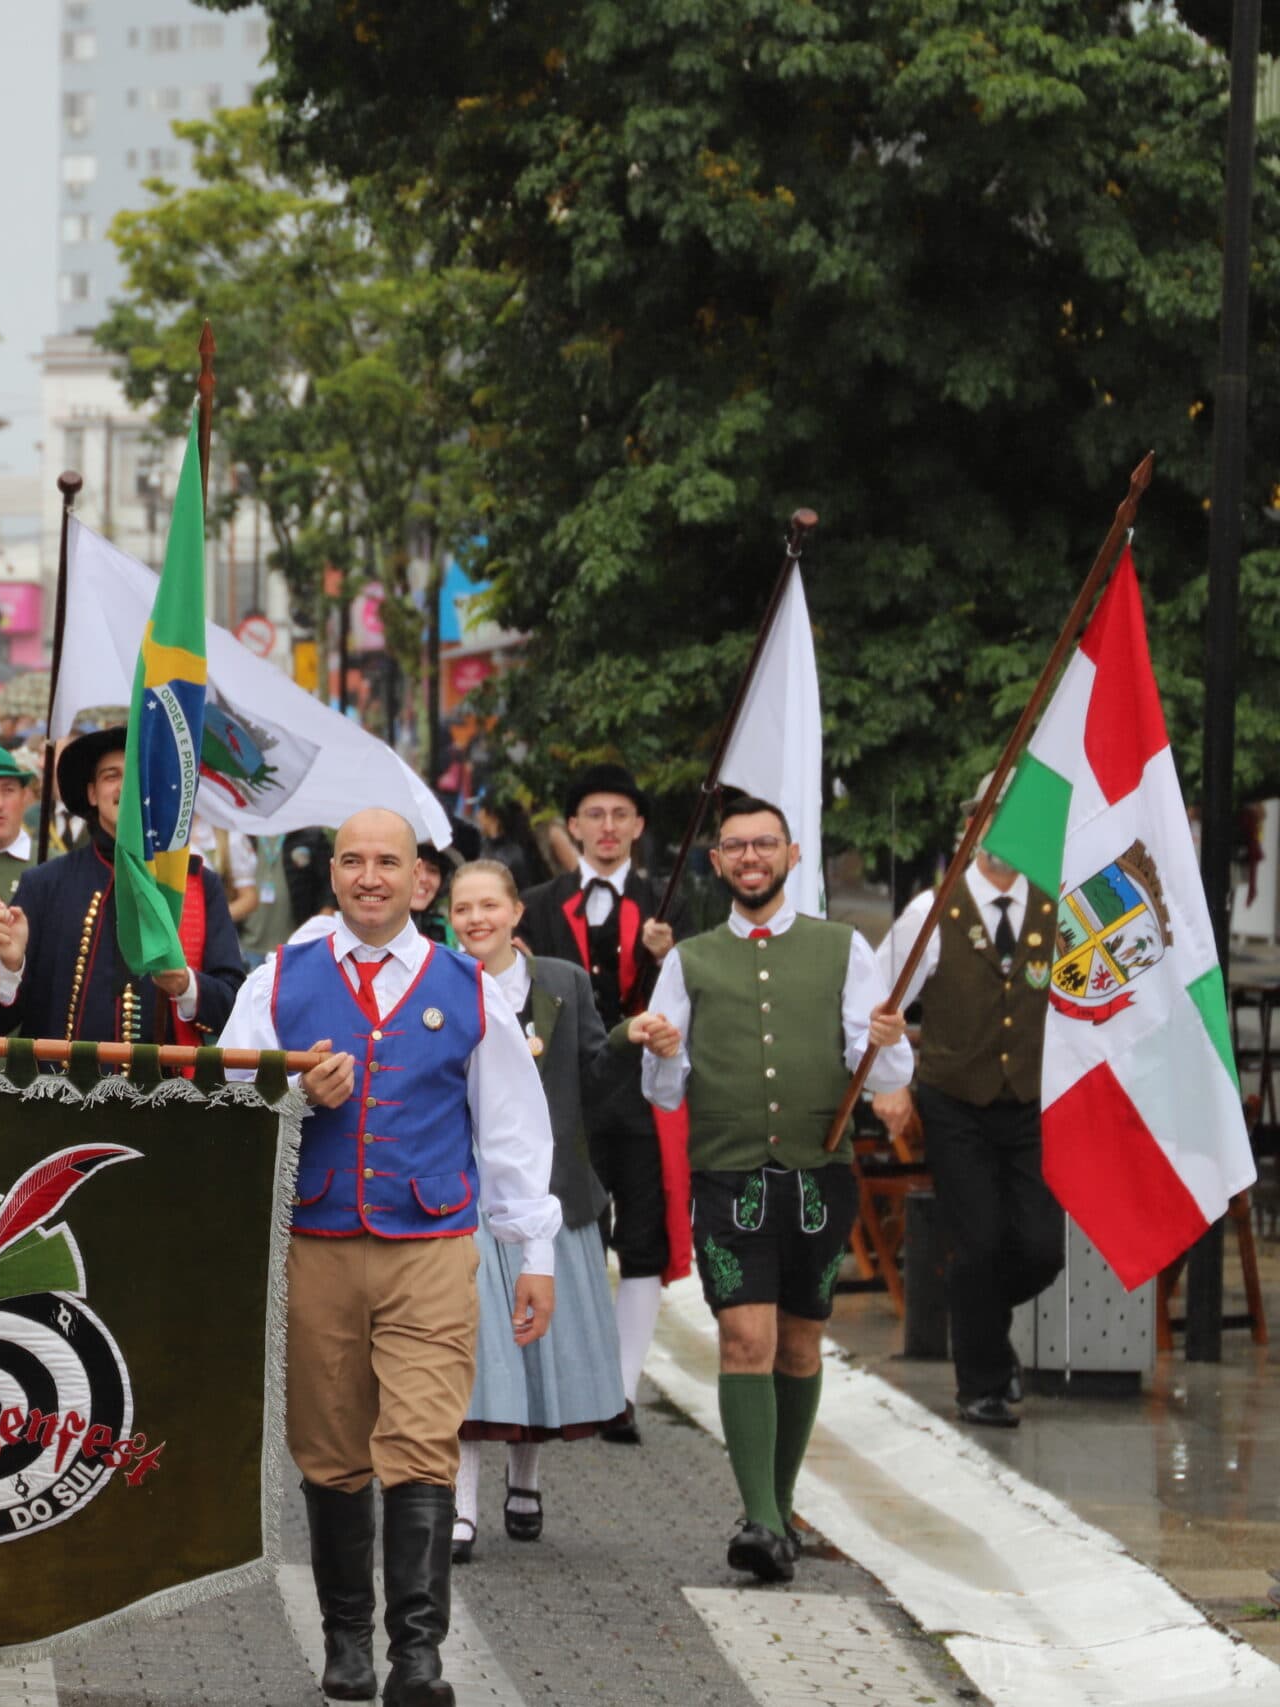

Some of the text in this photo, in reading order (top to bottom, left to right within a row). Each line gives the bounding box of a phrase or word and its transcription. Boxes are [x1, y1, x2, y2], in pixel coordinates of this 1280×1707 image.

[161, 689, 194, 839] ORDEM E PROGRESSO
[9, 1498, 53, 1531] DO
[51, 1461, 105, 1508] SUL
